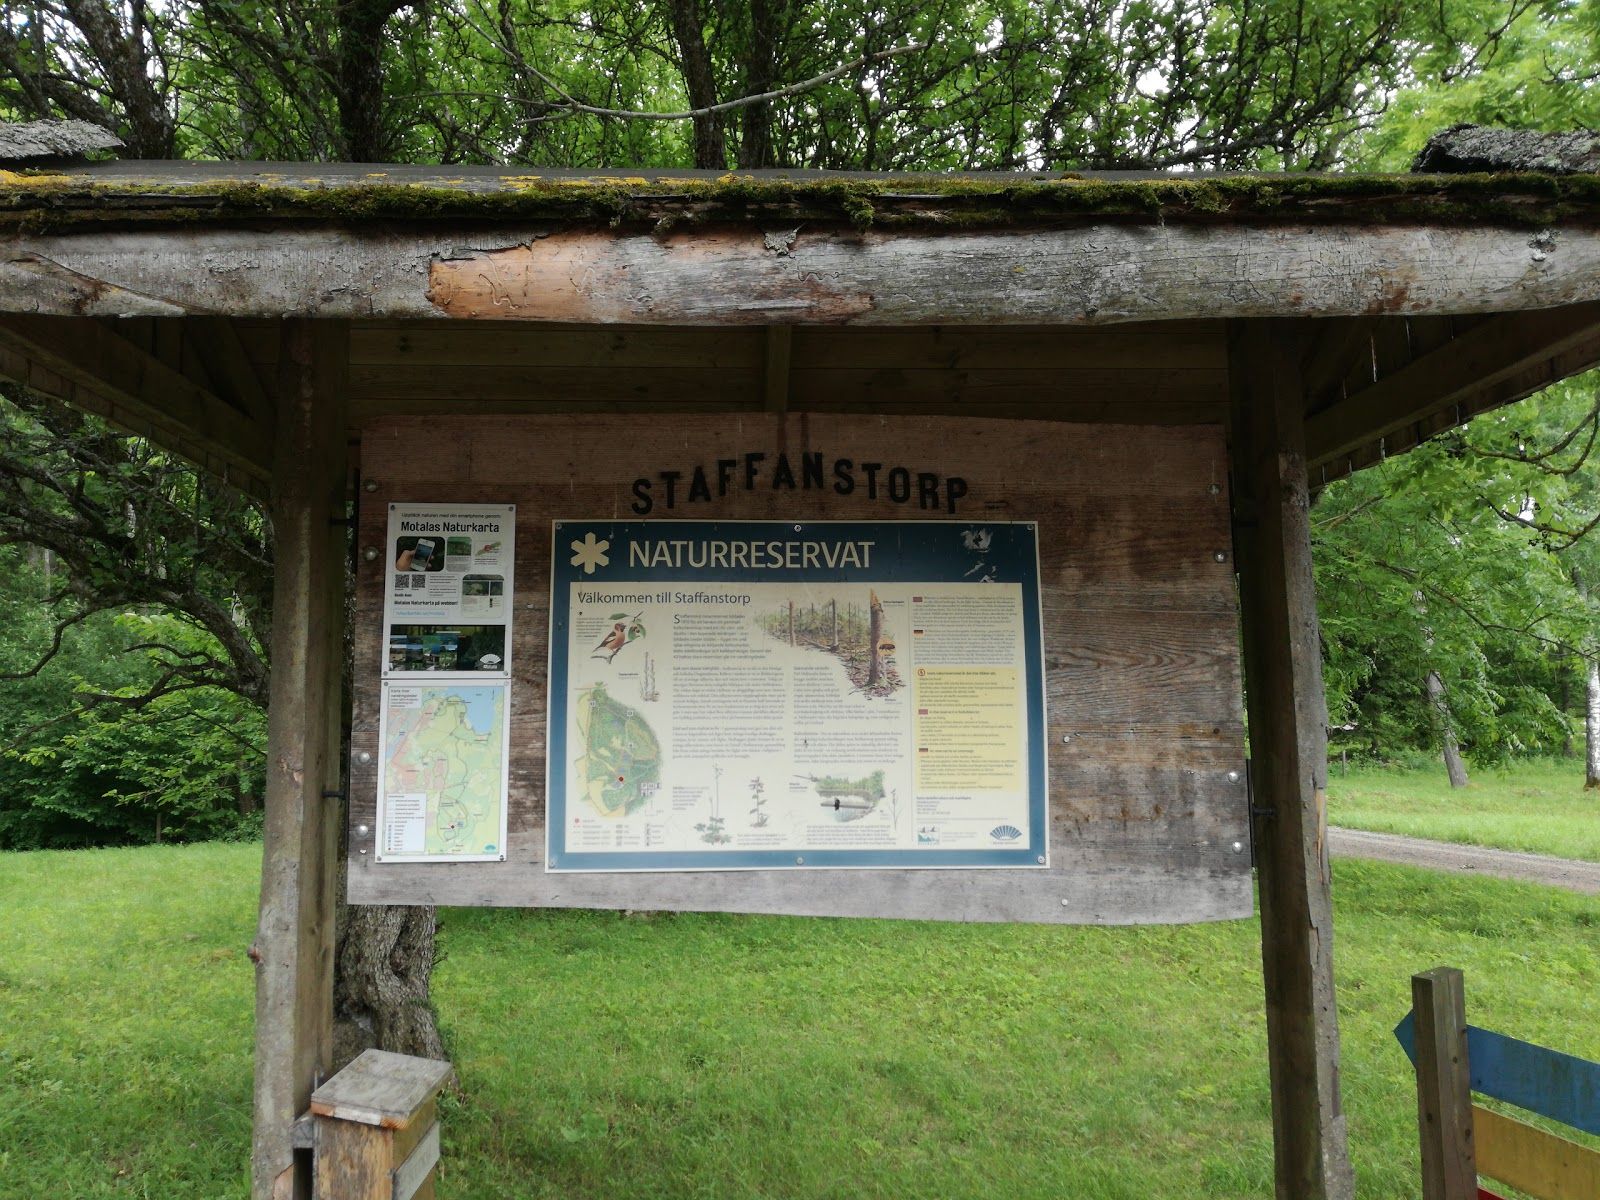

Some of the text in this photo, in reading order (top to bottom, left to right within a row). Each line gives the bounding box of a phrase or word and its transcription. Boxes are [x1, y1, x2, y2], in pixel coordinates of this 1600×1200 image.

[631, 452, 968, 515] STAFFANSTORP
[400, 521, 500, 533] Motalas Naturkarta
[629, 540, 875, 568] NATURRESERVAT
[578, 592, 751, 606] Välkommen till Staffanstorp
